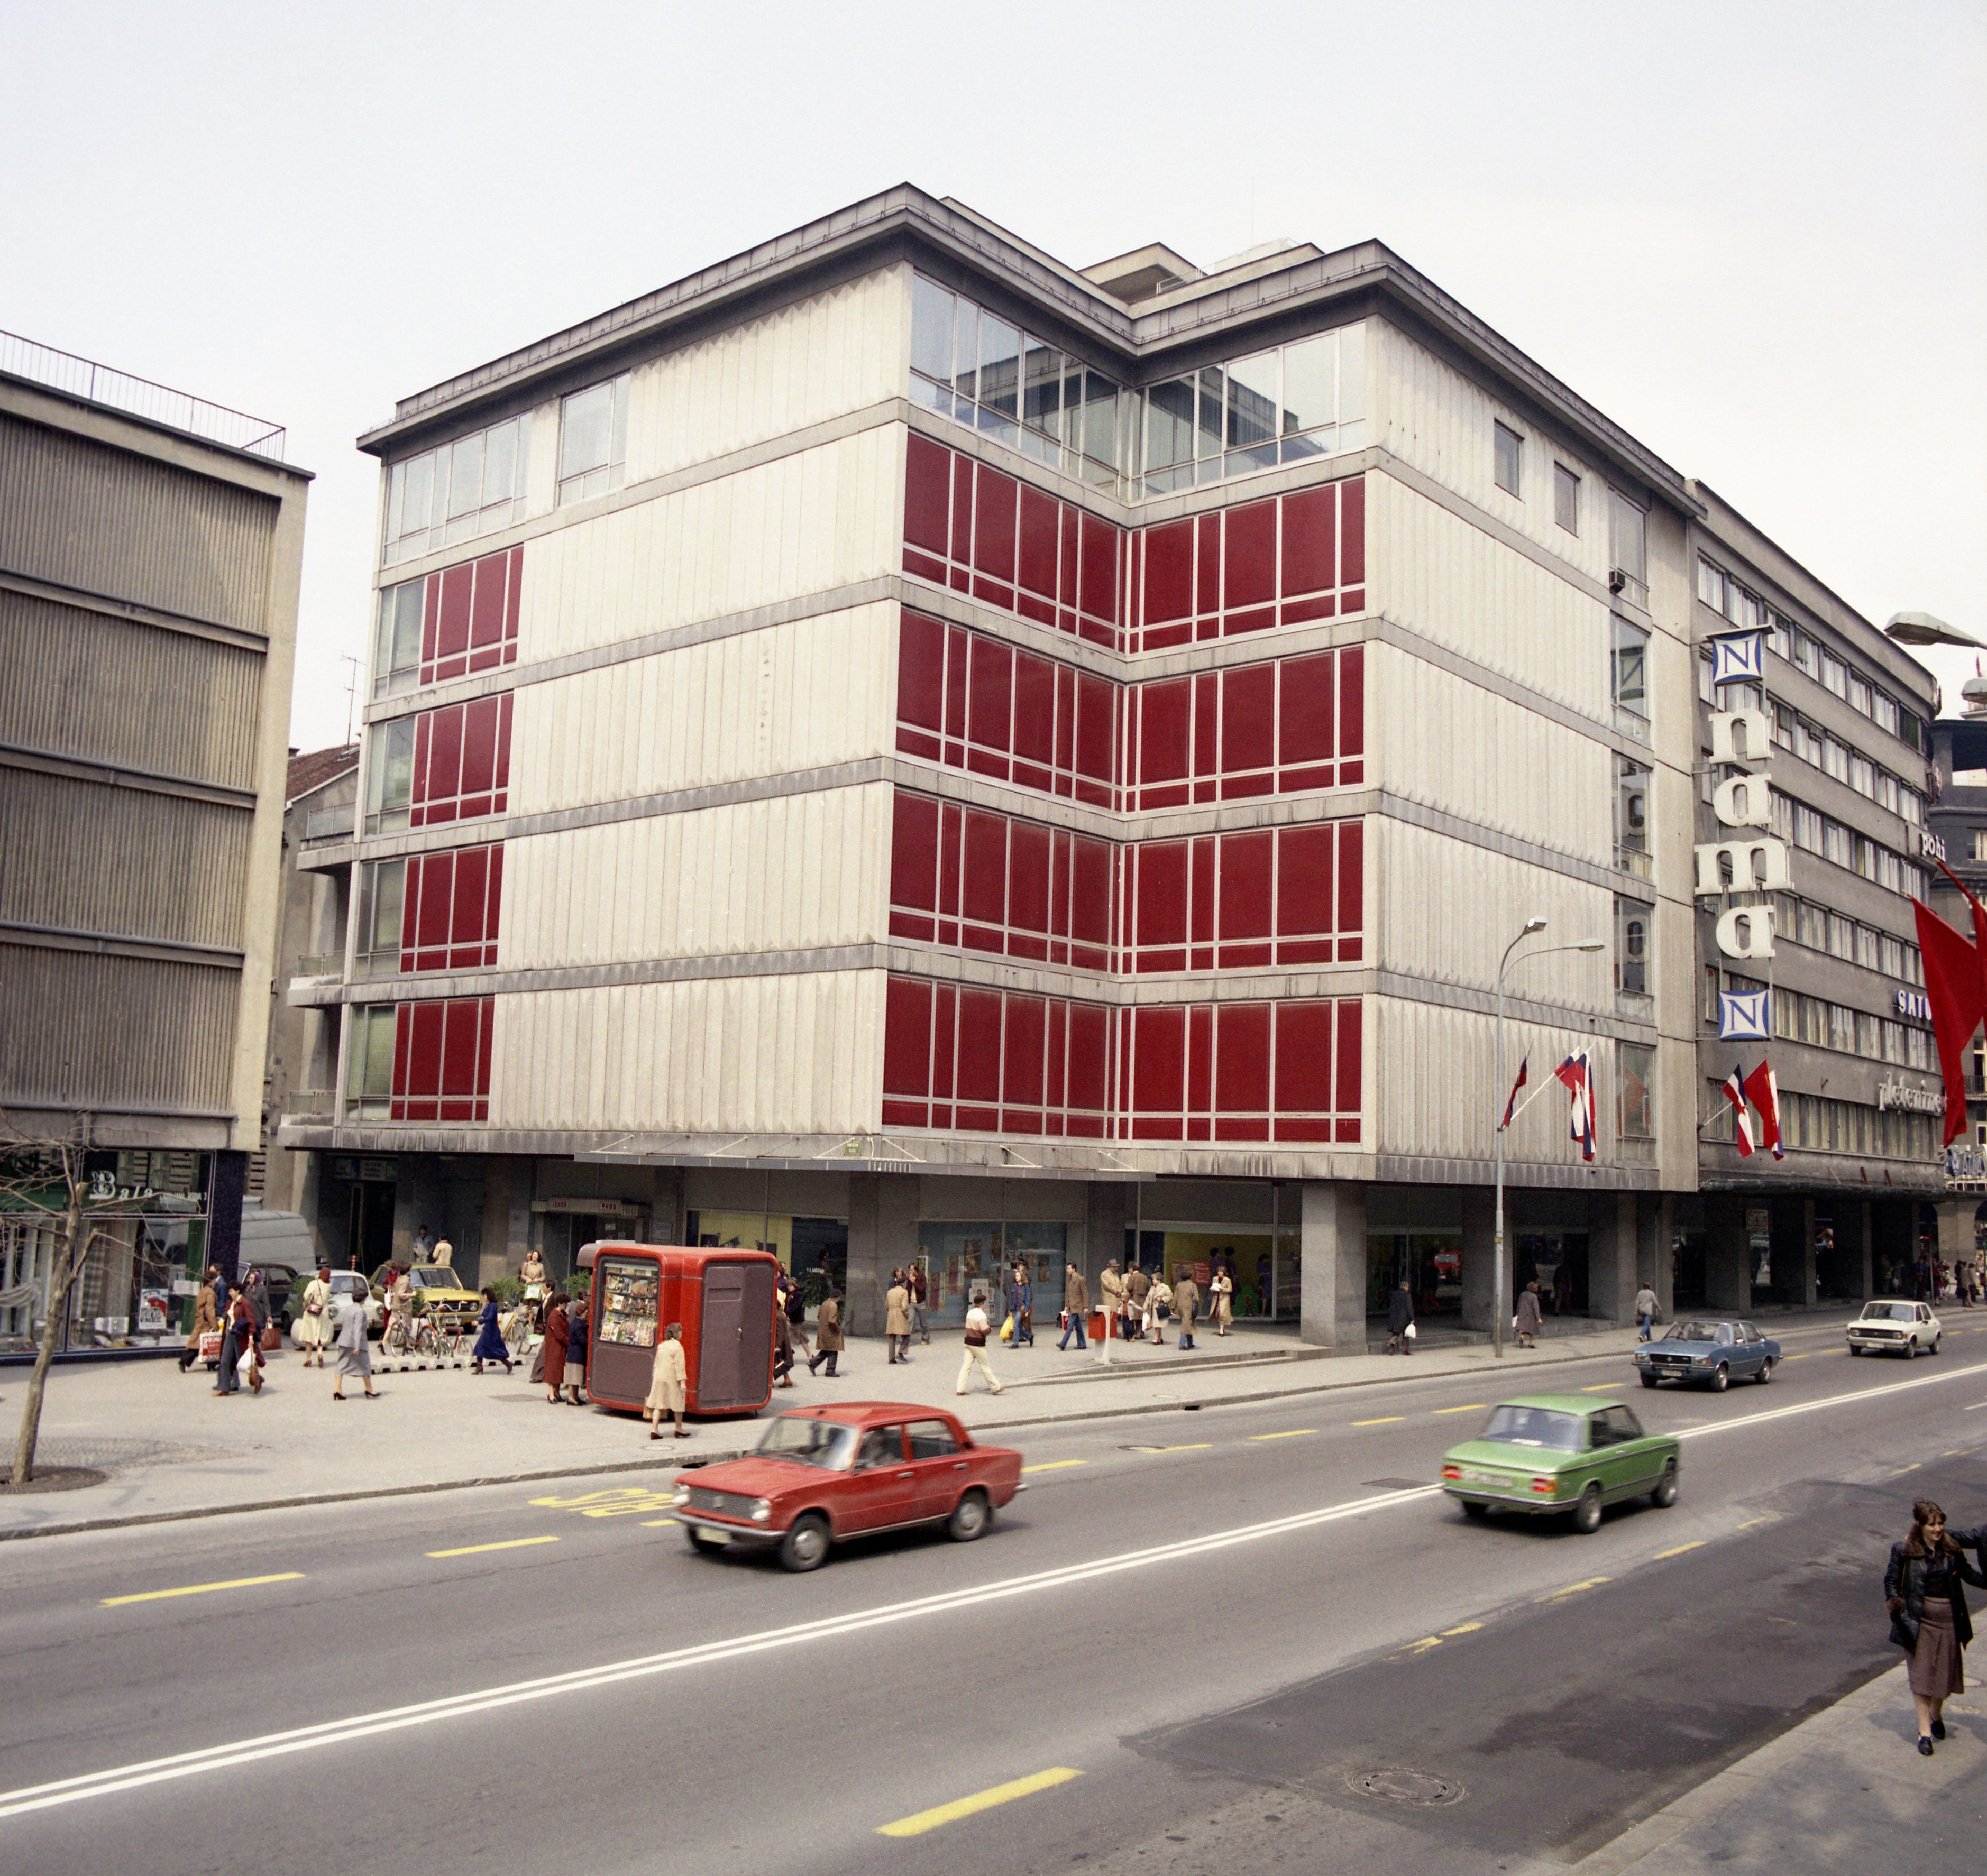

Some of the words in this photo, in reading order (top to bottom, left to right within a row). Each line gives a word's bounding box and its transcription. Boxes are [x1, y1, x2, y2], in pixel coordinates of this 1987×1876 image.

[1720, 640, 1752, 674] N
[1694, 707, 1794, 959] nama
[1727, 998, 1756, 1031] N
